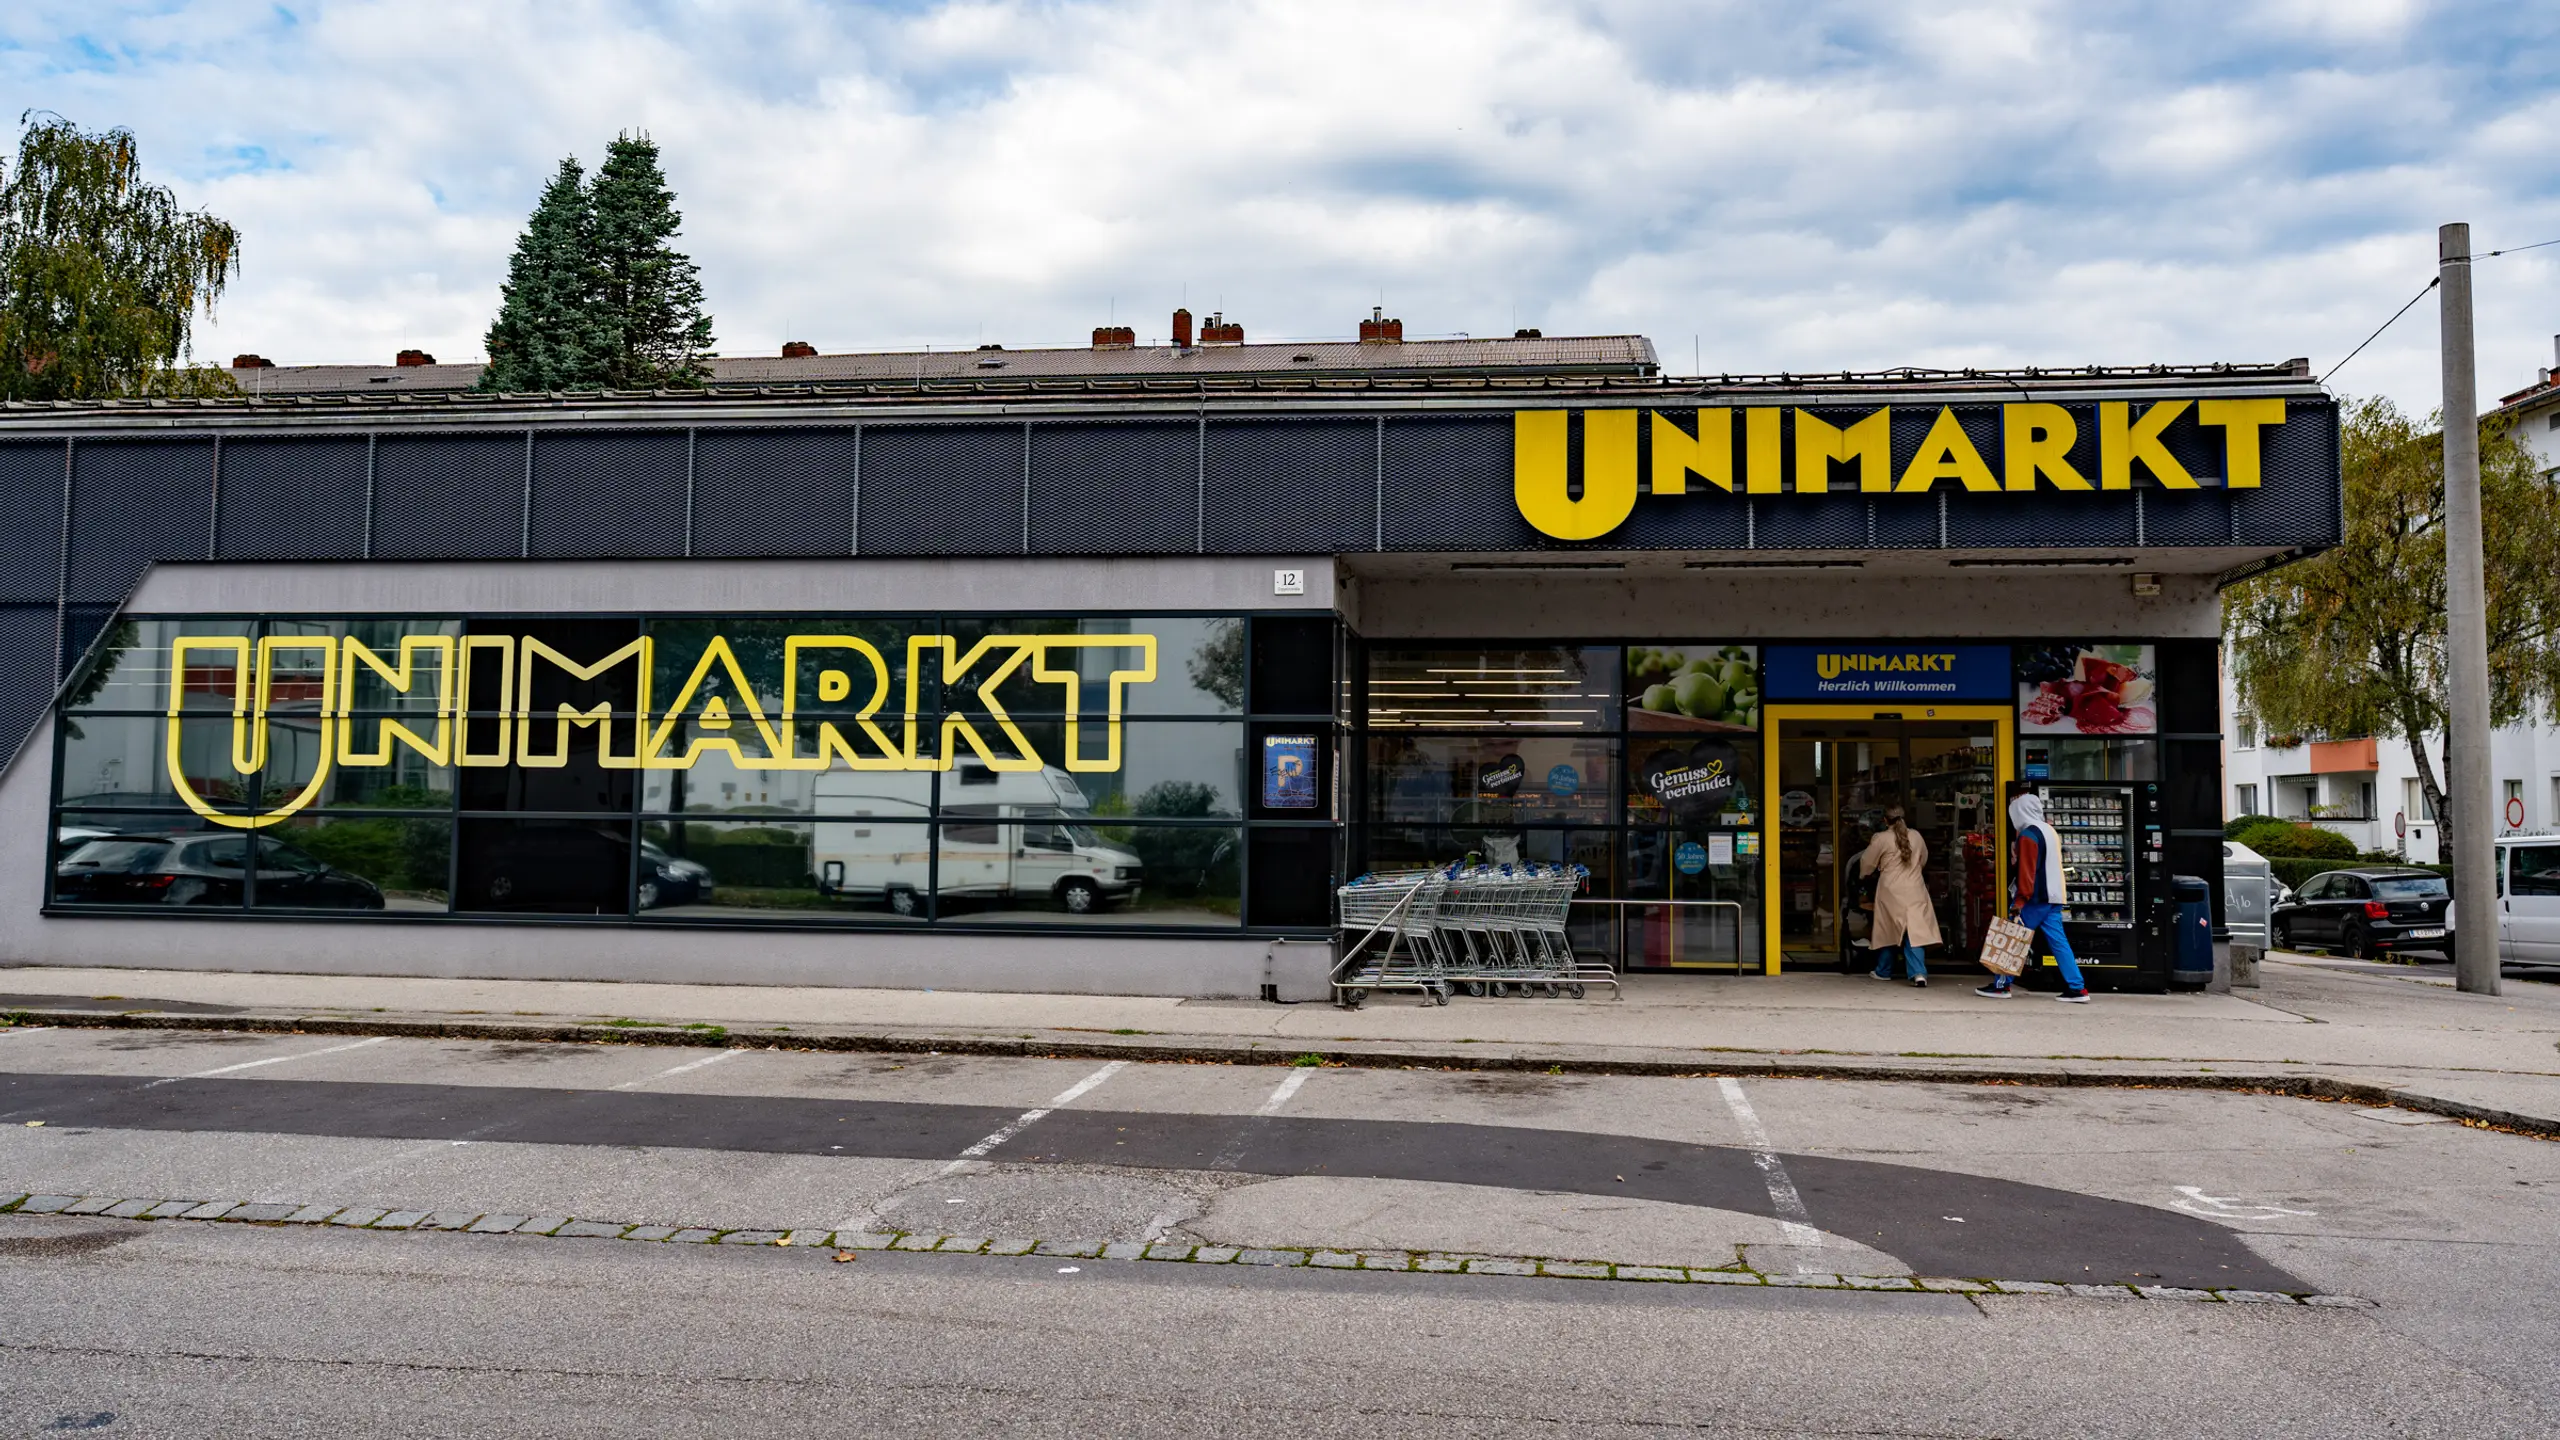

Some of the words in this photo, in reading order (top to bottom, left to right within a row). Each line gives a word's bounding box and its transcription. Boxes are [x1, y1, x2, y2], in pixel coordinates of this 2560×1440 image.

[1513, 397, 2286, 541] UNIMARKT
[1283, 572, 1296, 586] 12
[1816, 653, 1956, 680] UNIMARKT
[1818, 680, 1870, 692] Herzlich
[1874, 680, 1956, 692] Willkommen
[167, 634, 1158, 829] UNIMARKT
[1266, 736, 1316, 747] UNIMARKT
[1277, 755, 1304, 787] P
[1482, 768, 1510, 785] Genuss
[1489, 770, 1523, 788] verbindet
[1650, 767, 1709, 793] Genuss
[1665, 774, 1732, 800] verbindet
